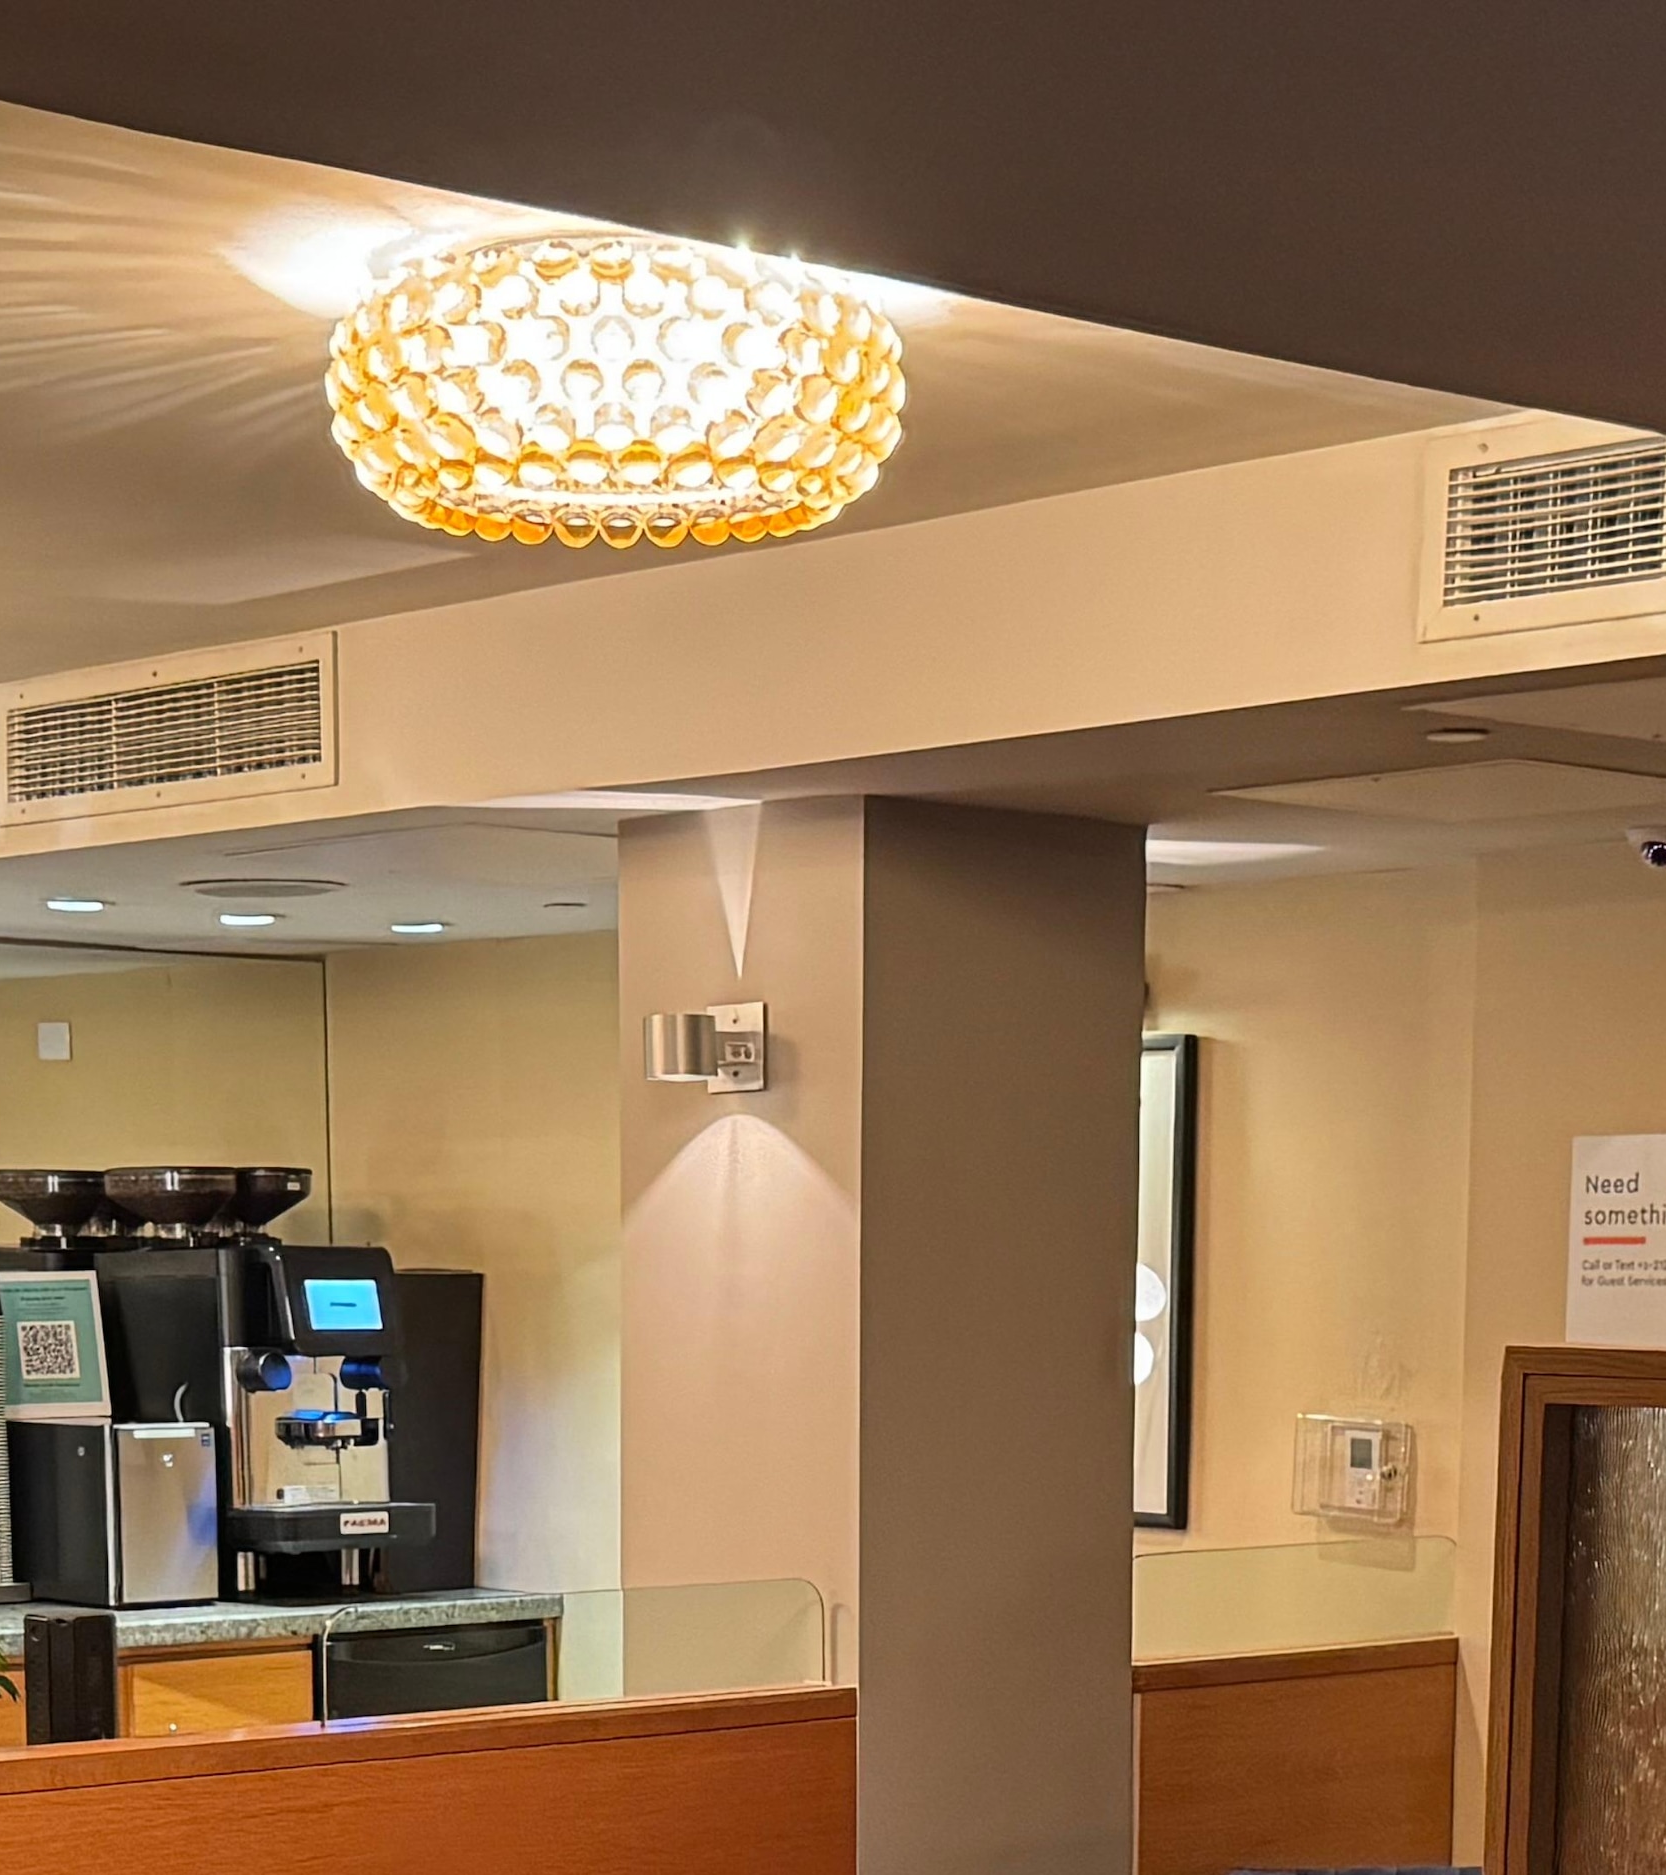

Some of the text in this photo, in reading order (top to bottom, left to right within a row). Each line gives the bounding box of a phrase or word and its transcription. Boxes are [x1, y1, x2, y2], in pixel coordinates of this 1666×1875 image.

[1585, 1171, 1639, 1194] Need
[1582, 1259, 1600, 1270] Call
[1602, 1261, 1612, 1270] or
[1615, 1259, 1635, 1270] Text
[1581, 1275, 1594, 1286] for
[1597, 1275, 1625, 1286] Guest
